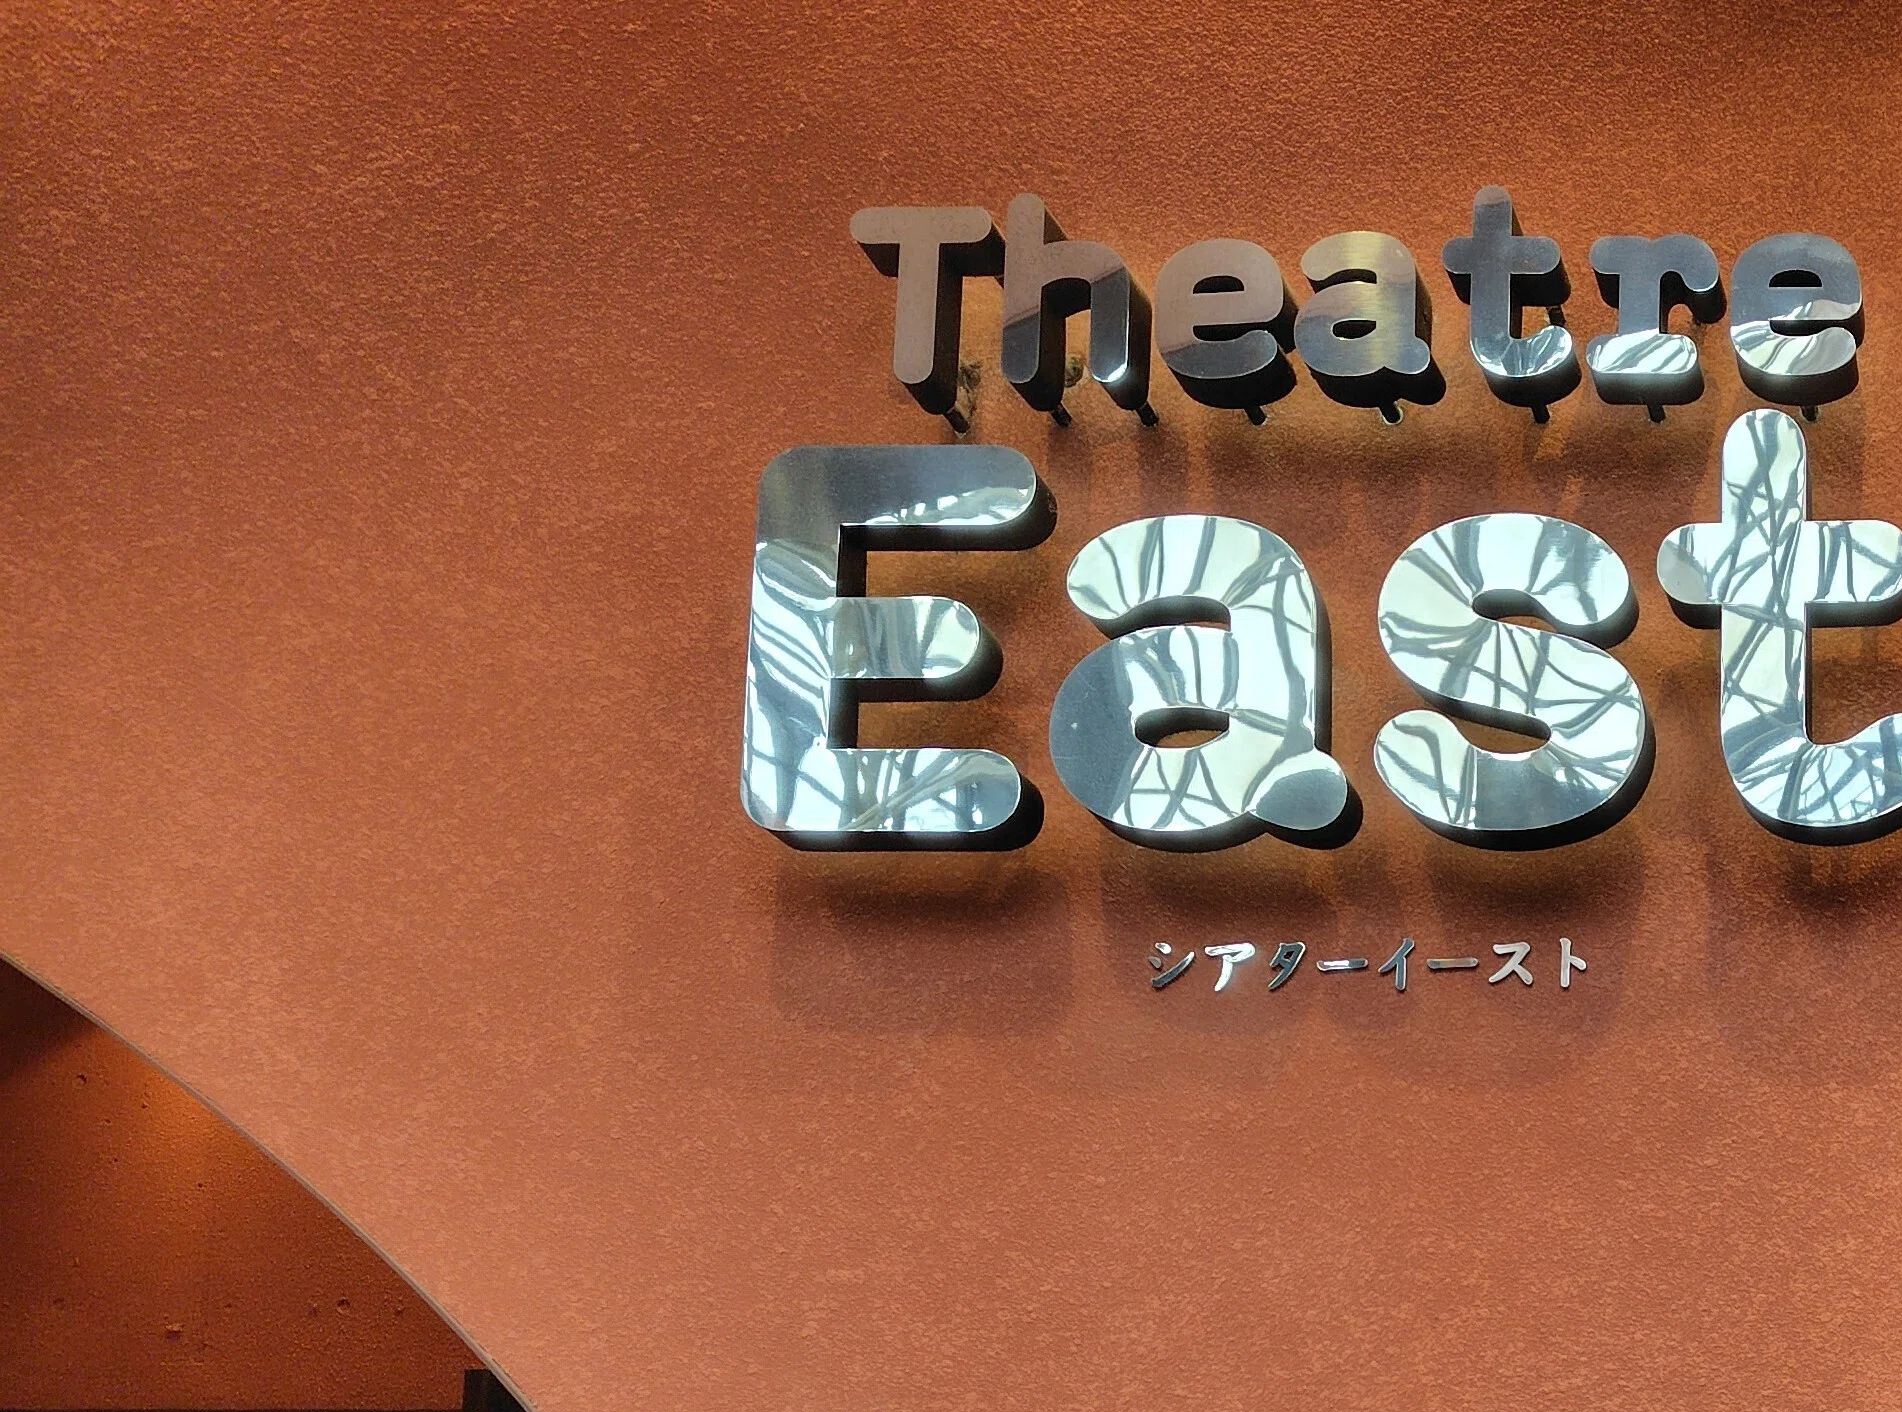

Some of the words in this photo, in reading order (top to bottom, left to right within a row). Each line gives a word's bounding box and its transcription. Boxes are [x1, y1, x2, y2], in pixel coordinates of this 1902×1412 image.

[848, 186, 1866, 392] Theatre
[1146, 934, 1590, 992] シアターイースト
